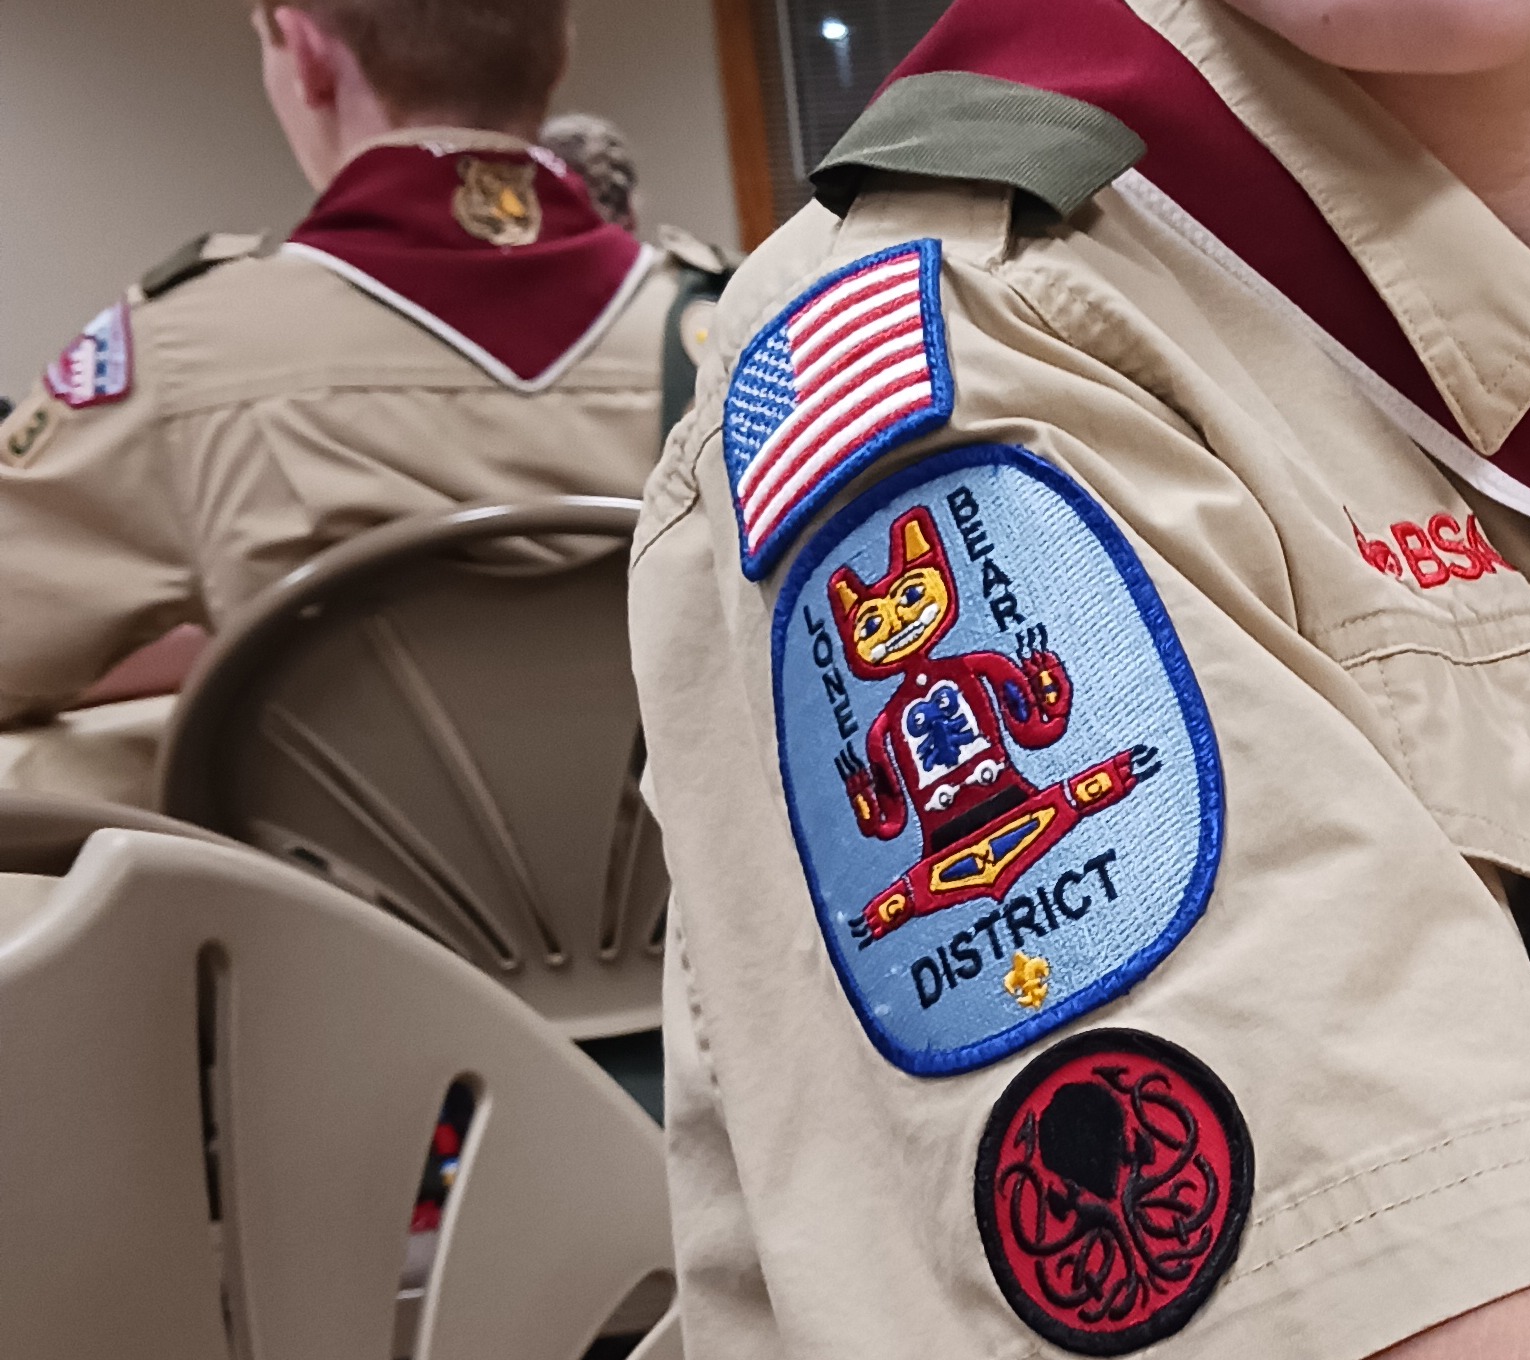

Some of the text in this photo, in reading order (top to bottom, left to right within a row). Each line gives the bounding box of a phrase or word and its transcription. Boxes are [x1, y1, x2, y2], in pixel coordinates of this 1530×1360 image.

[947, 486, 1026, 632] BEAR
[803, 605, 859, 739] LONE
[911, 848, 1118, 1010] DISTRICT
